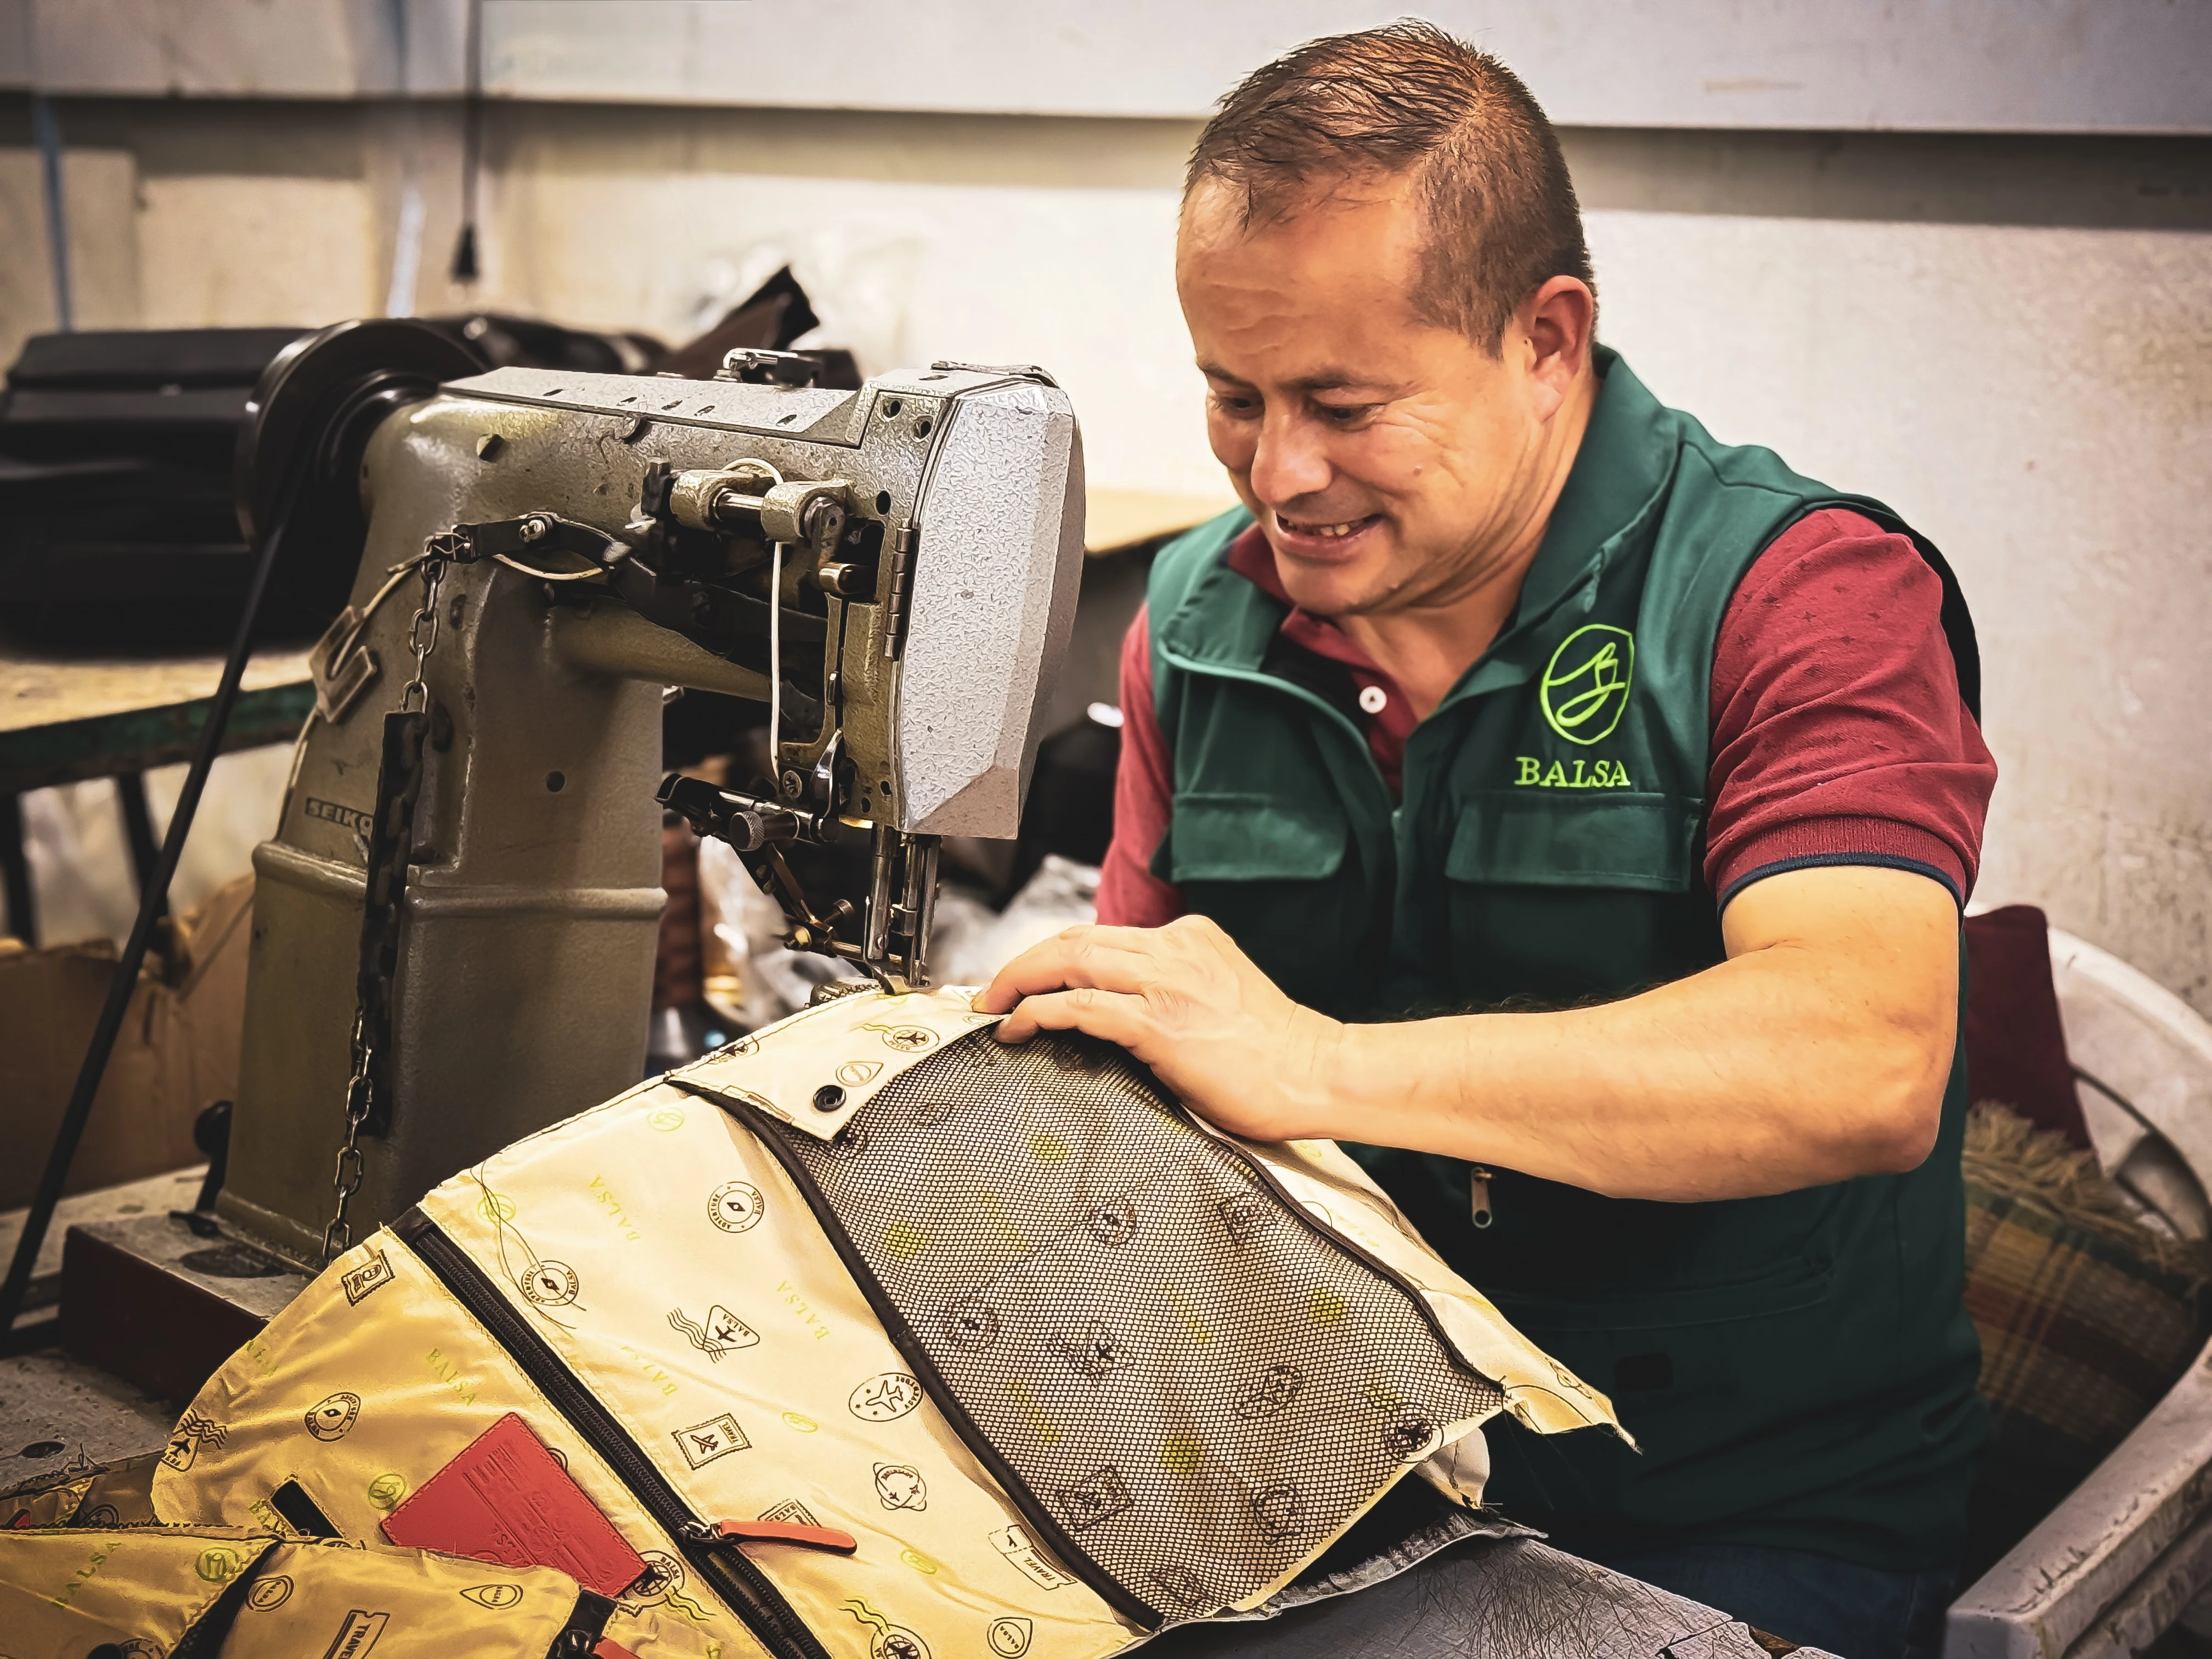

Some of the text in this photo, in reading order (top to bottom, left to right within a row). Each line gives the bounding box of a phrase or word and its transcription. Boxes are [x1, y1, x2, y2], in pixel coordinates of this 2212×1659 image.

[1514, 757, 1631, 787] BALSA
[589, 1175, 641, 1240] BALSA
[776, 1279, 830, 1340] BALSA
[723, 1313, 750, 1337] BALSA
[660, 1556, 681, 1579] BALSA
[1023, 1556, 1057, 1581] TRAVEL
[337, 1623, 371, 1659] TRAVE
